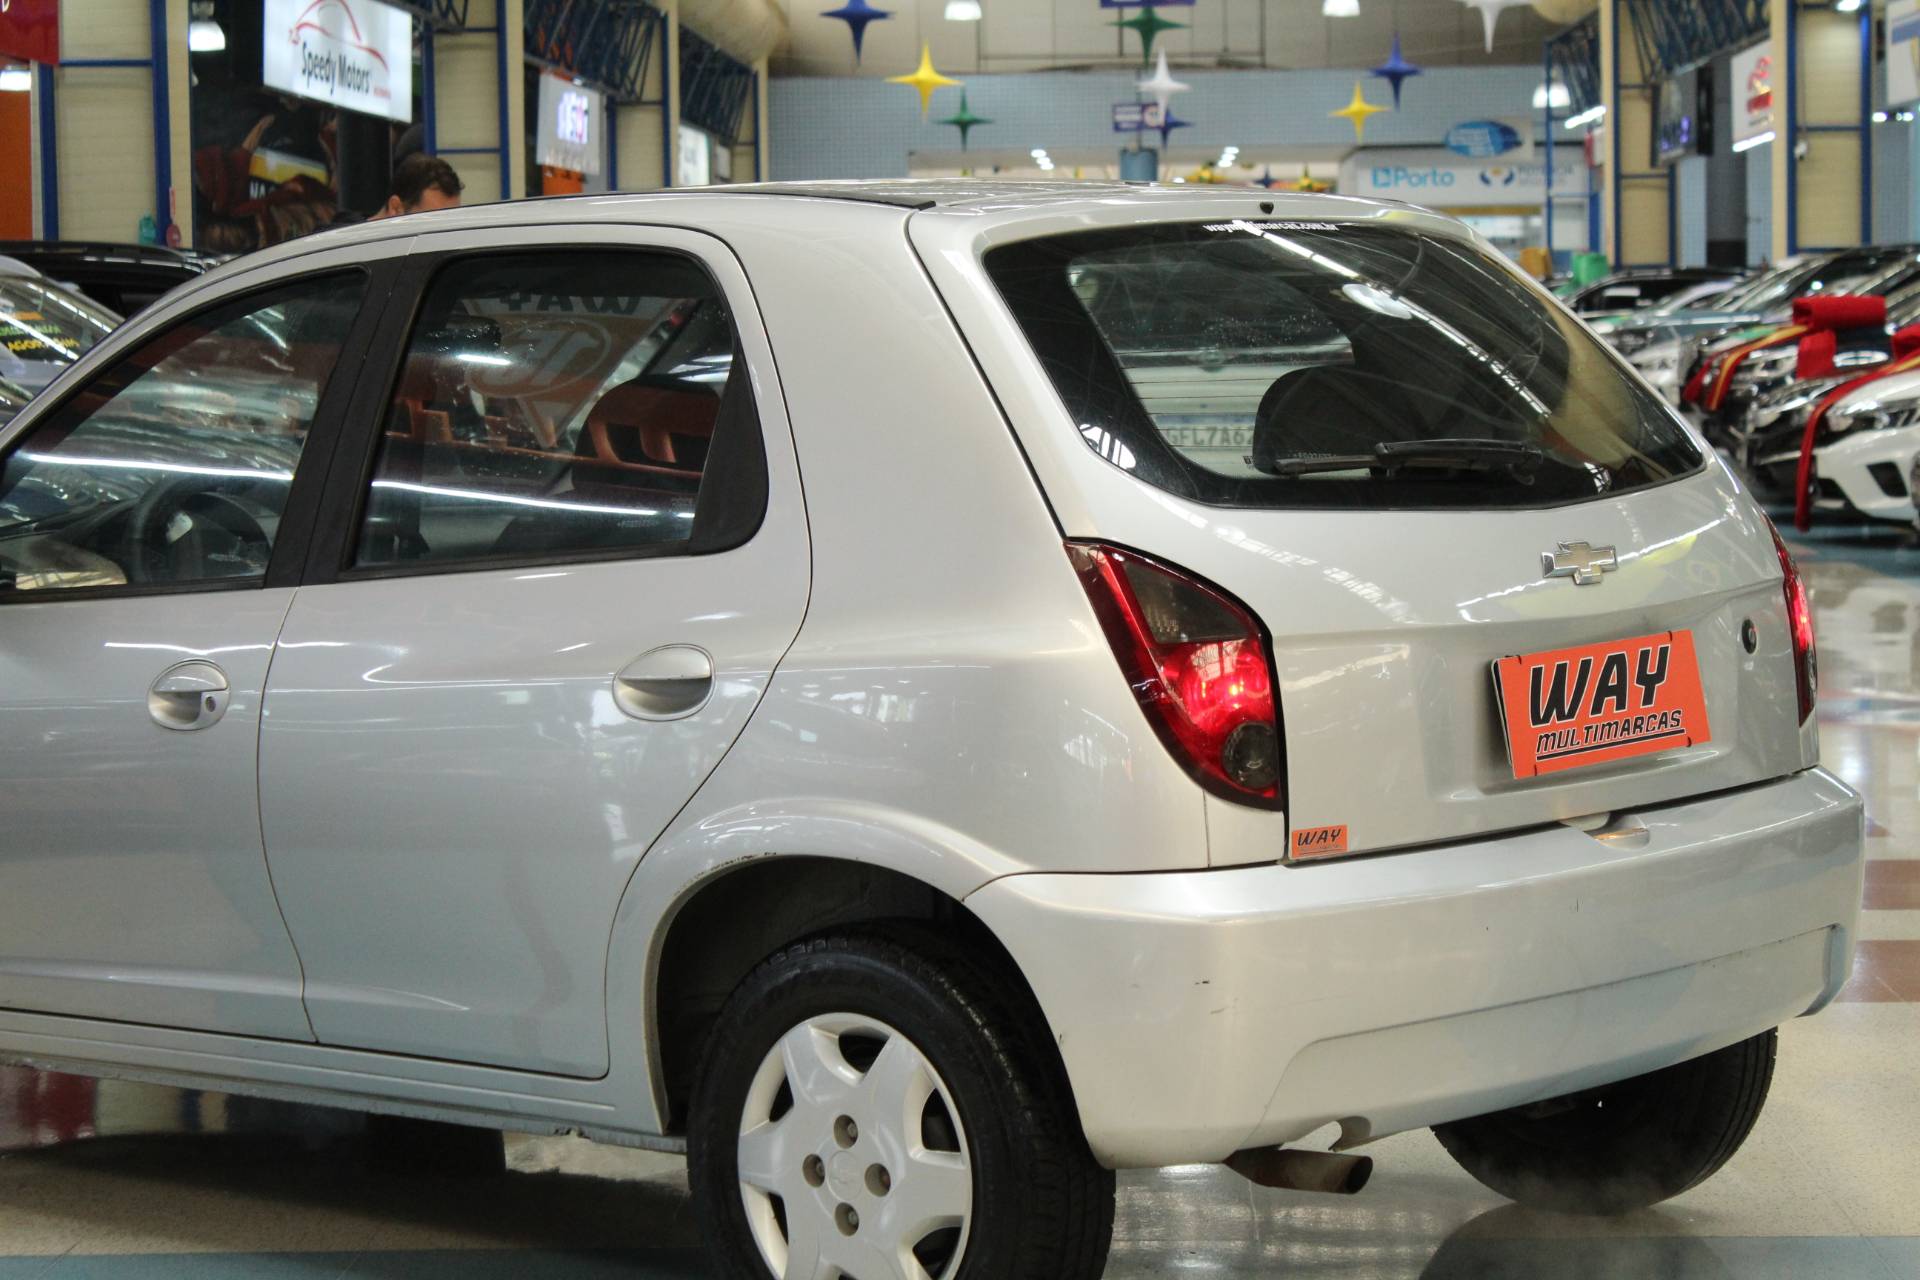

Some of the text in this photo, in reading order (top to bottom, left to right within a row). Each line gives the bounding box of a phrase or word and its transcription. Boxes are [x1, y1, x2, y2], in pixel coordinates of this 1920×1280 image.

[302, 41, 371, 96] Speedy Motors
[1393, 167, 1455, 188] Porto
[1529, 644, 1671, 728] WAY
[1536, 709, 1683, 754] MULTIMARCAS
[1297, 828, 1342, 847] WAY
